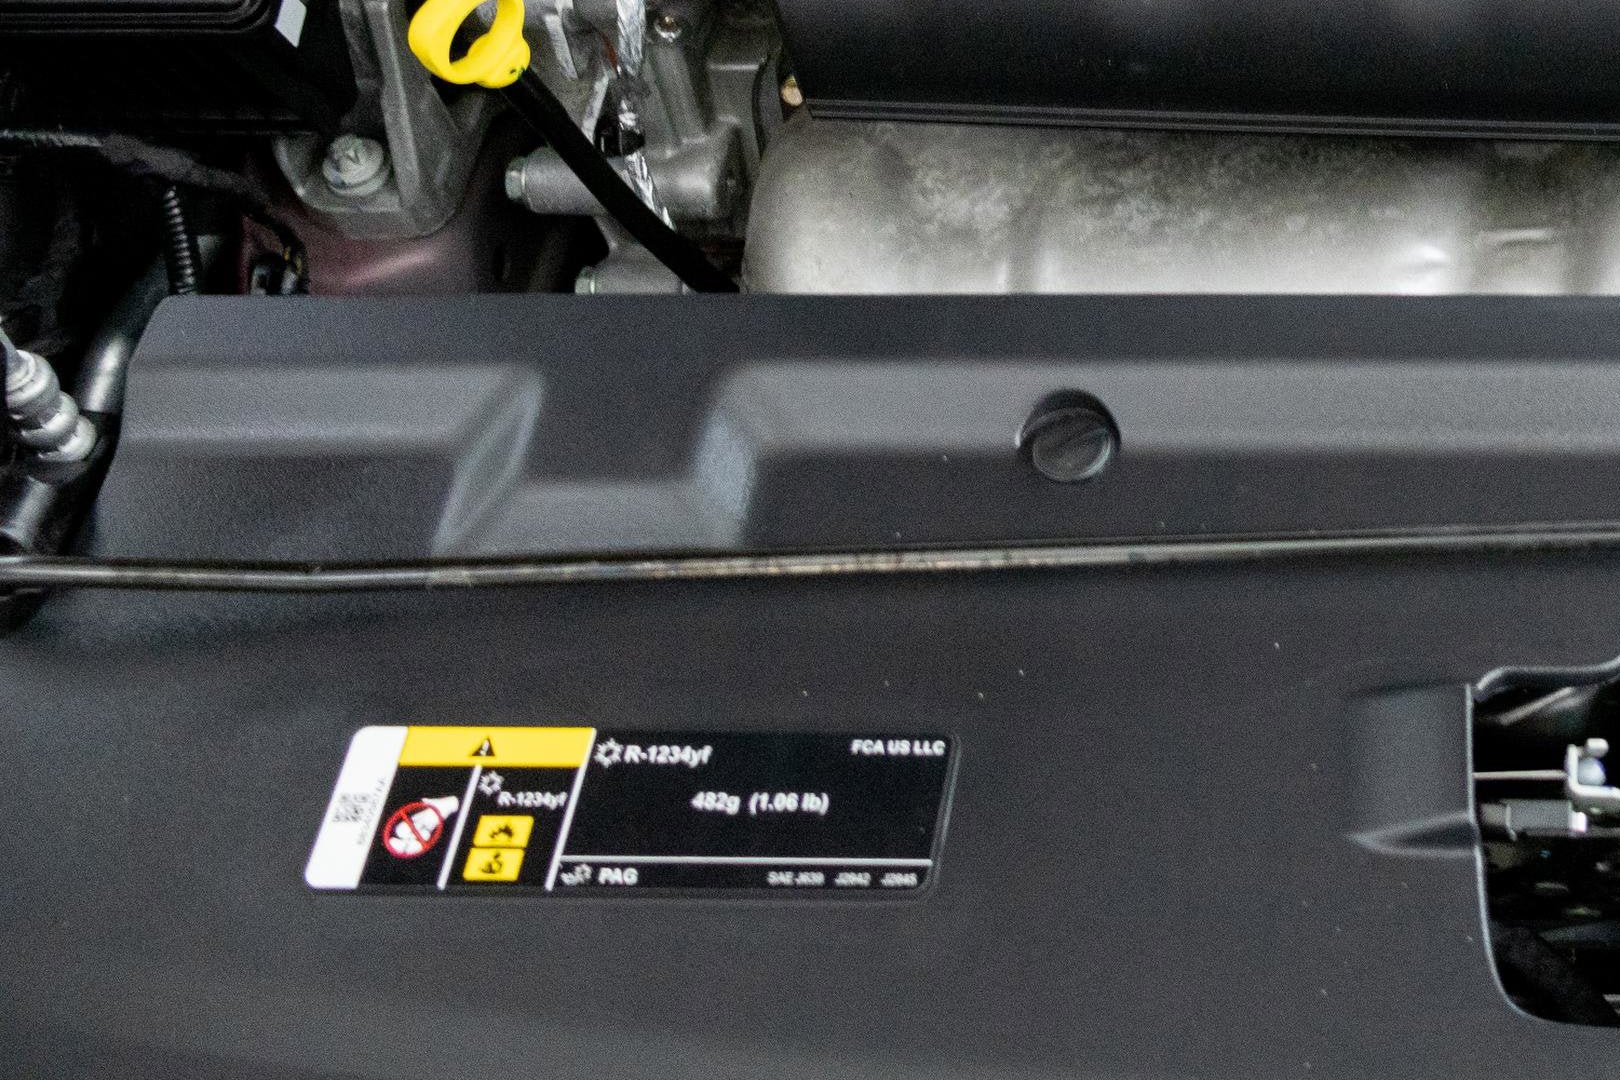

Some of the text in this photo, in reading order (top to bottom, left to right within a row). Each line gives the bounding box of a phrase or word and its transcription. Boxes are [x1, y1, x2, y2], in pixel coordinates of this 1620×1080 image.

[623, 744, 713, 767] R-1234yf
[851, 739, 947, 757] FCA US LLC
[497, 789, 568, 810] R-1234yf
[692, 792, 742, 814] 482g
[801, 792, 831, 816] lb)
[597, 865, 639, 886] PAG
